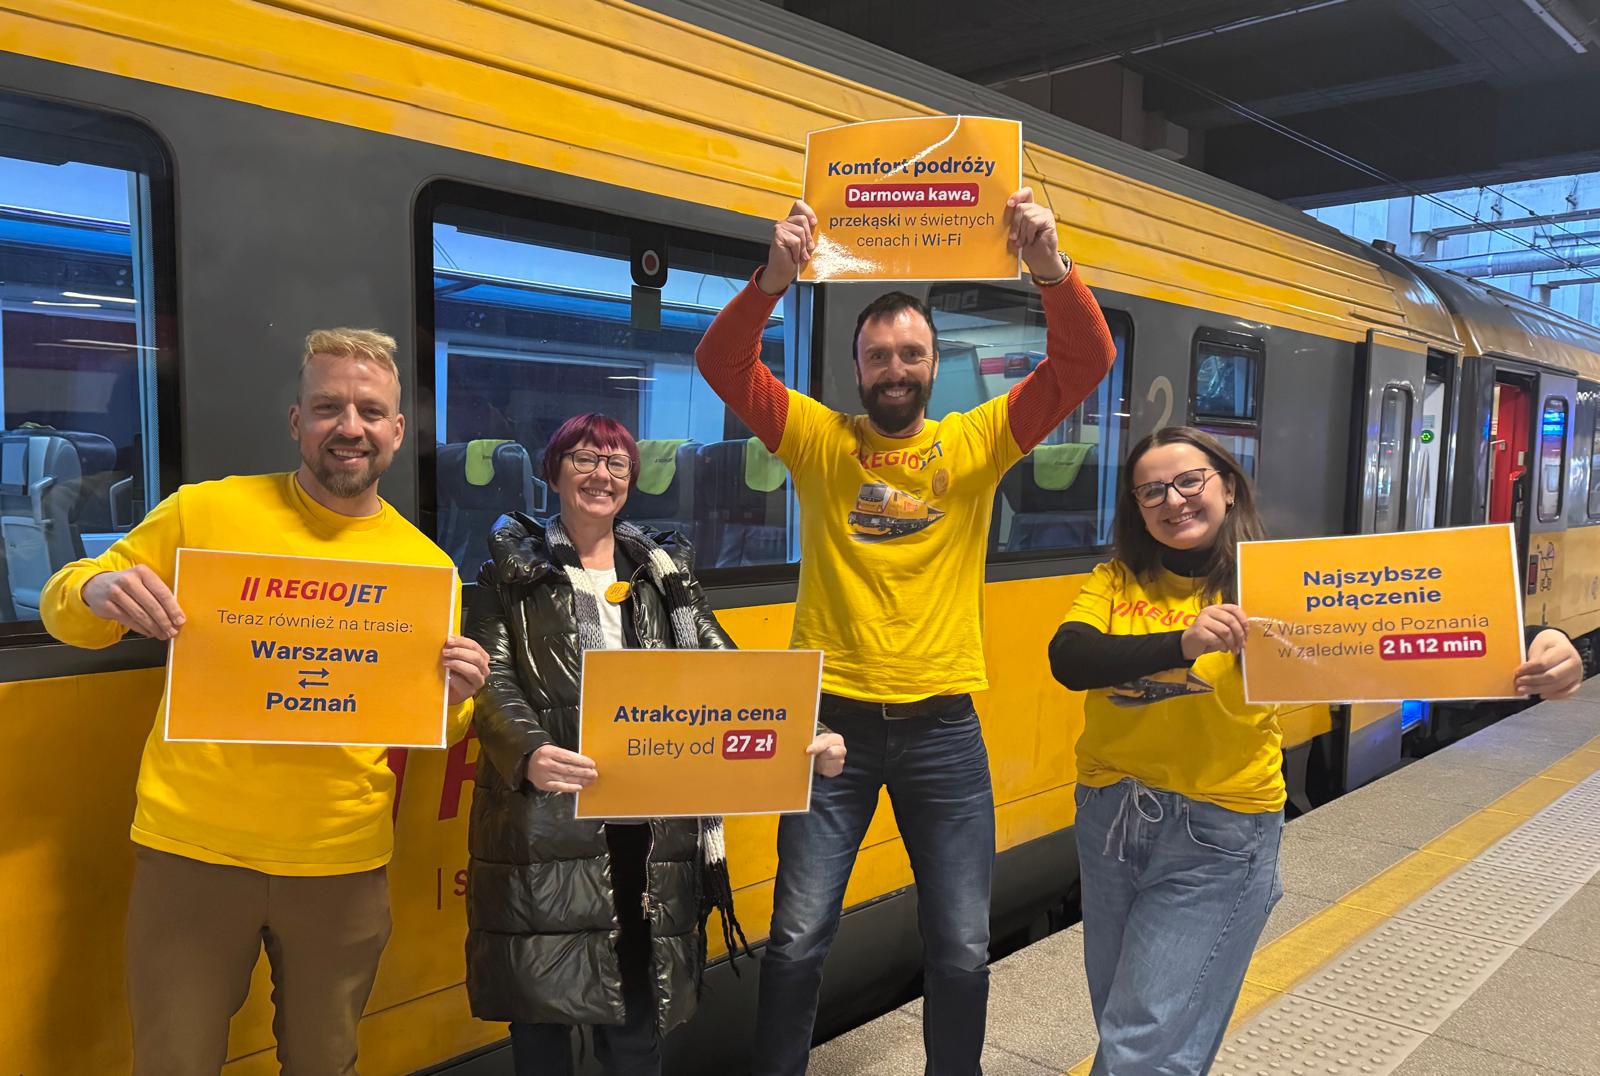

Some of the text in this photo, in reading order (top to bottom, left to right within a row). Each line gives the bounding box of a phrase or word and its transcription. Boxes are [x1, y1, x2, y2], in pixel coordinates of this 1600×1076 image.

[828, 156, 996, 177] Komfort podróży
[848, 187, 975, 203] Darmowa kawa,
[829, 213, 995, 229] przekąski w świetnych
[857, 233, 961, 247] cenach i Wi-Fi
[1303, 566, 1442, 588] Najszybsze
[265, 578, 387, 607] REGIOJET
[1306, 587, 1442, 612] połączenie
[217, 609, 413, 633] Teraz również na trasie:
[1278, 621, 1368, 637] Warszawy
[1372, 617, 1396, 632] do
[1401, 615, 1489, 631] Poznania
[251, 640, 379, 663] Warszawa
[1277, 636, 1483, 658] w zaledwie 2 h 12 min
[266, 692, 356, 712] Poznań
[613, 705, 787, 726] Atrakcyjna cena
[627, 734, 774, 759] Bilety od 27 zł
